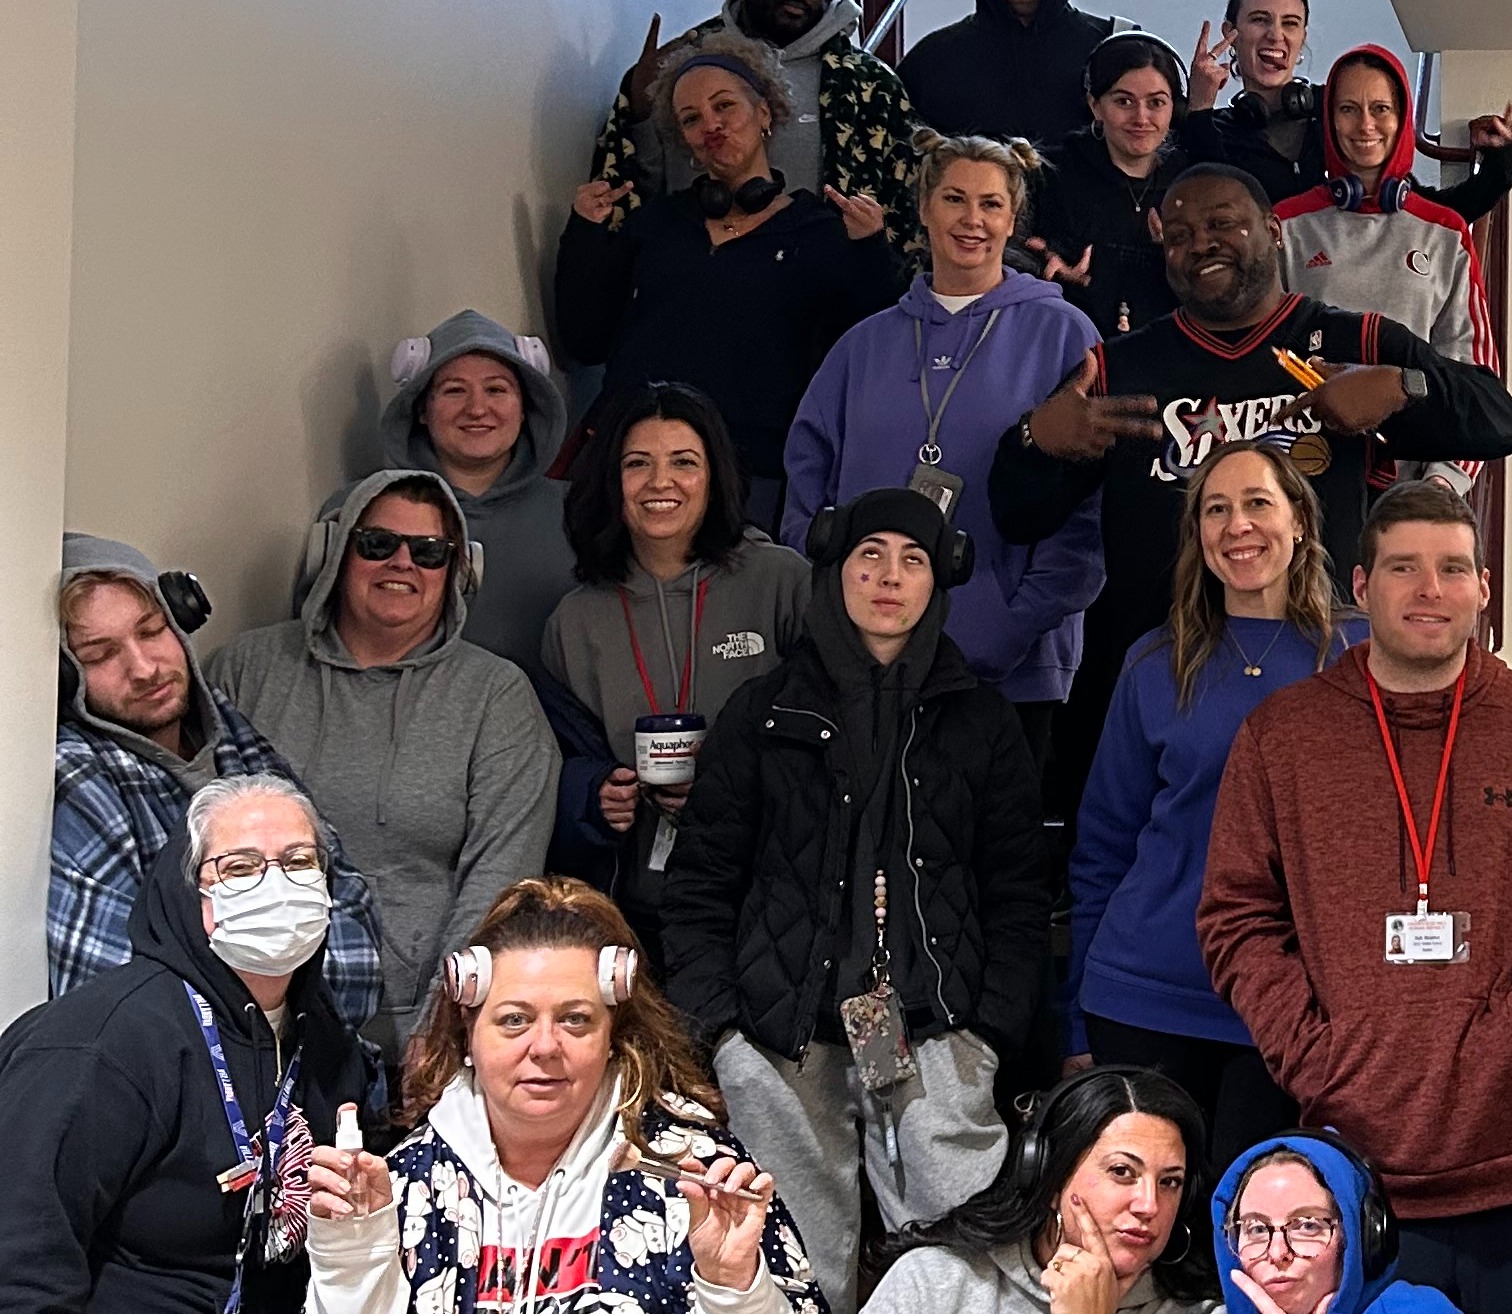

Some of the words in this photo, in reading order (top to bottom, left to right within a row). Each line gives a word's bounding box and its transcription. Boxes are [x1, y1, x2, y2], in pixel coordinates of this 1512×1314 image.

[726, 632, 748, 643] THE
[712, 640, 748, 655] NORTH
[723, 649, 749, 660] FACE
